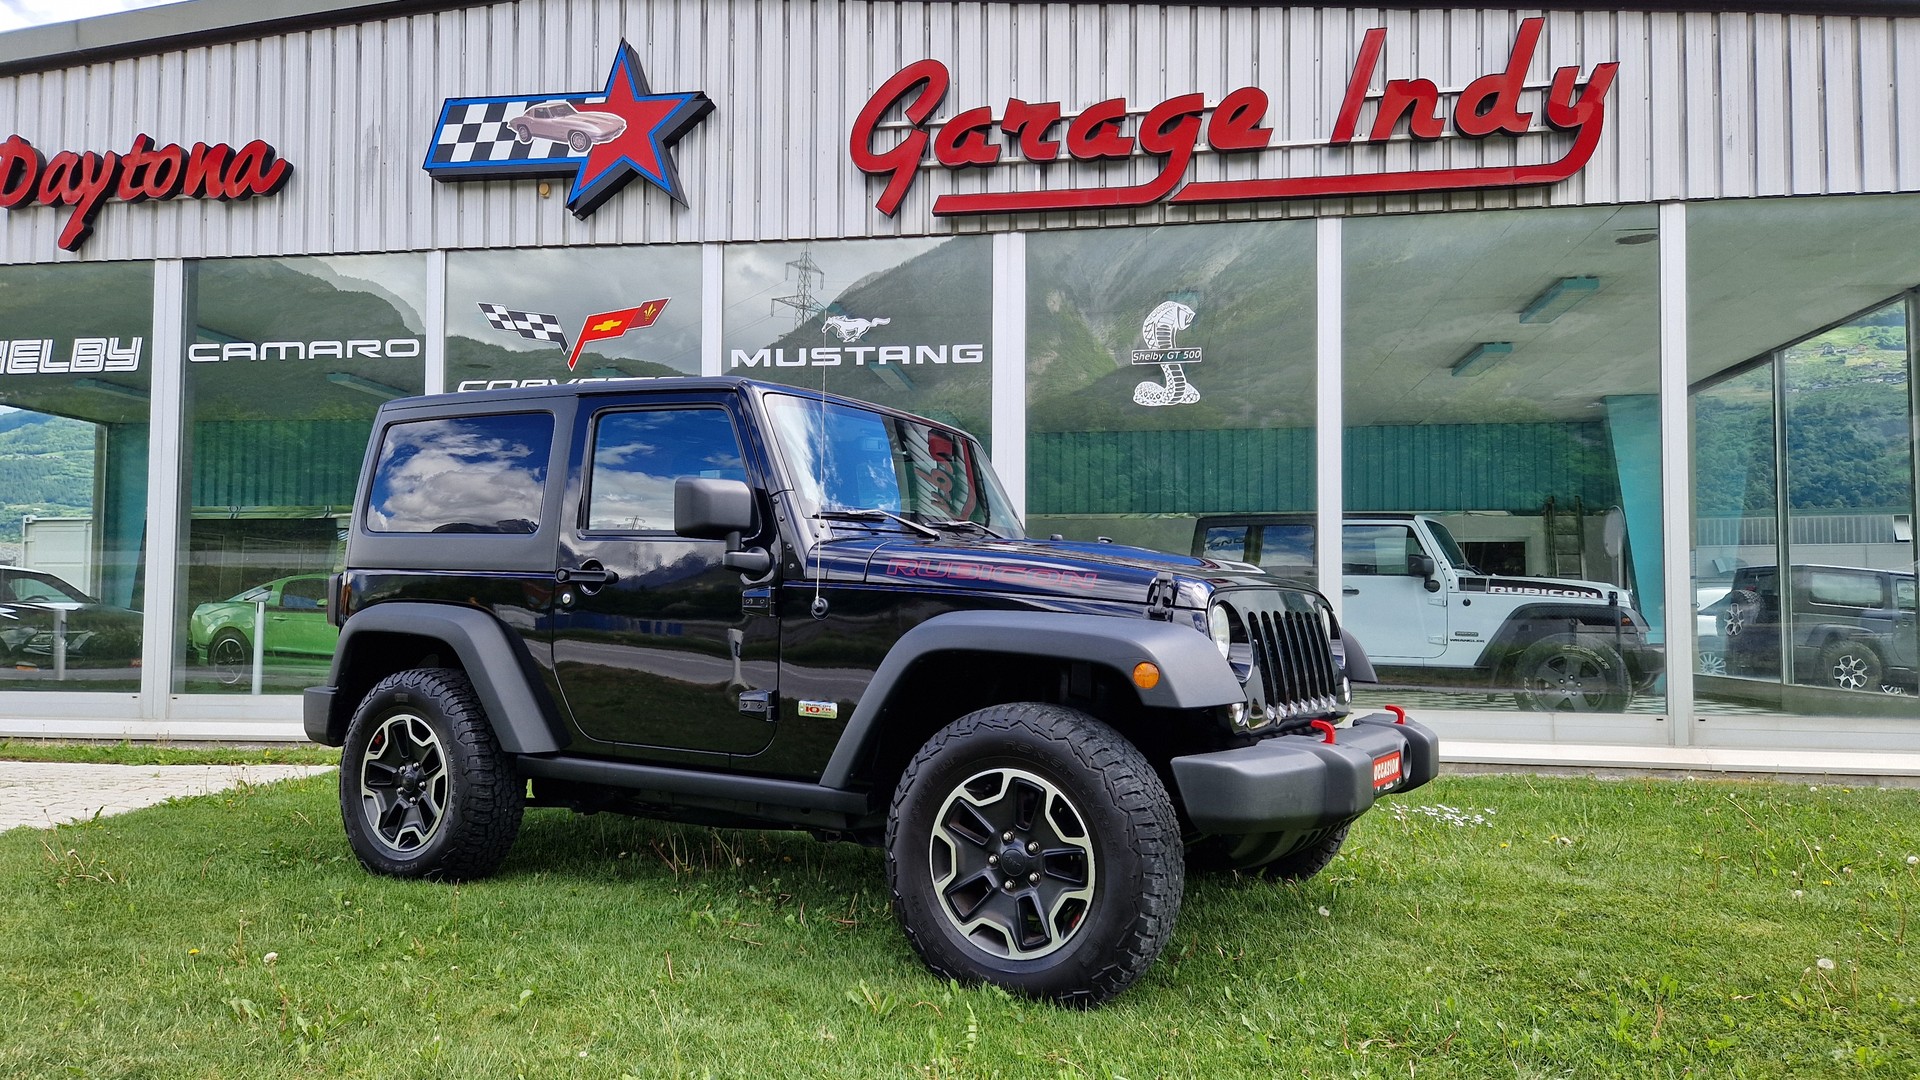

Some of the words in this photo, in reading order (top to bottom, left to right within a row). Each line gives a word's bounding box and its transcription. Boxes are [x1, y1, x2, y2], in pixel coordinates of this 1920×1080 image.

[850, 58, 1274, 218] Garage
[1170, 16, 1620, 207] Indy
[0, 132, 293, 252] Daytona
[188, 338, 420, 363] CAMARO
[730, 343, 984, 368] MUSTANG
[1132, 351, 1165, 362] Shelby
[1166, 351, 1181, 360] GT
[1182, 350, 1201, 360] 500
[886, 558, 1098, 590] RUBICON
[1489, 585, 1598, 599] RUBICON
[1373, 756, 1400, 781] OCCASION
